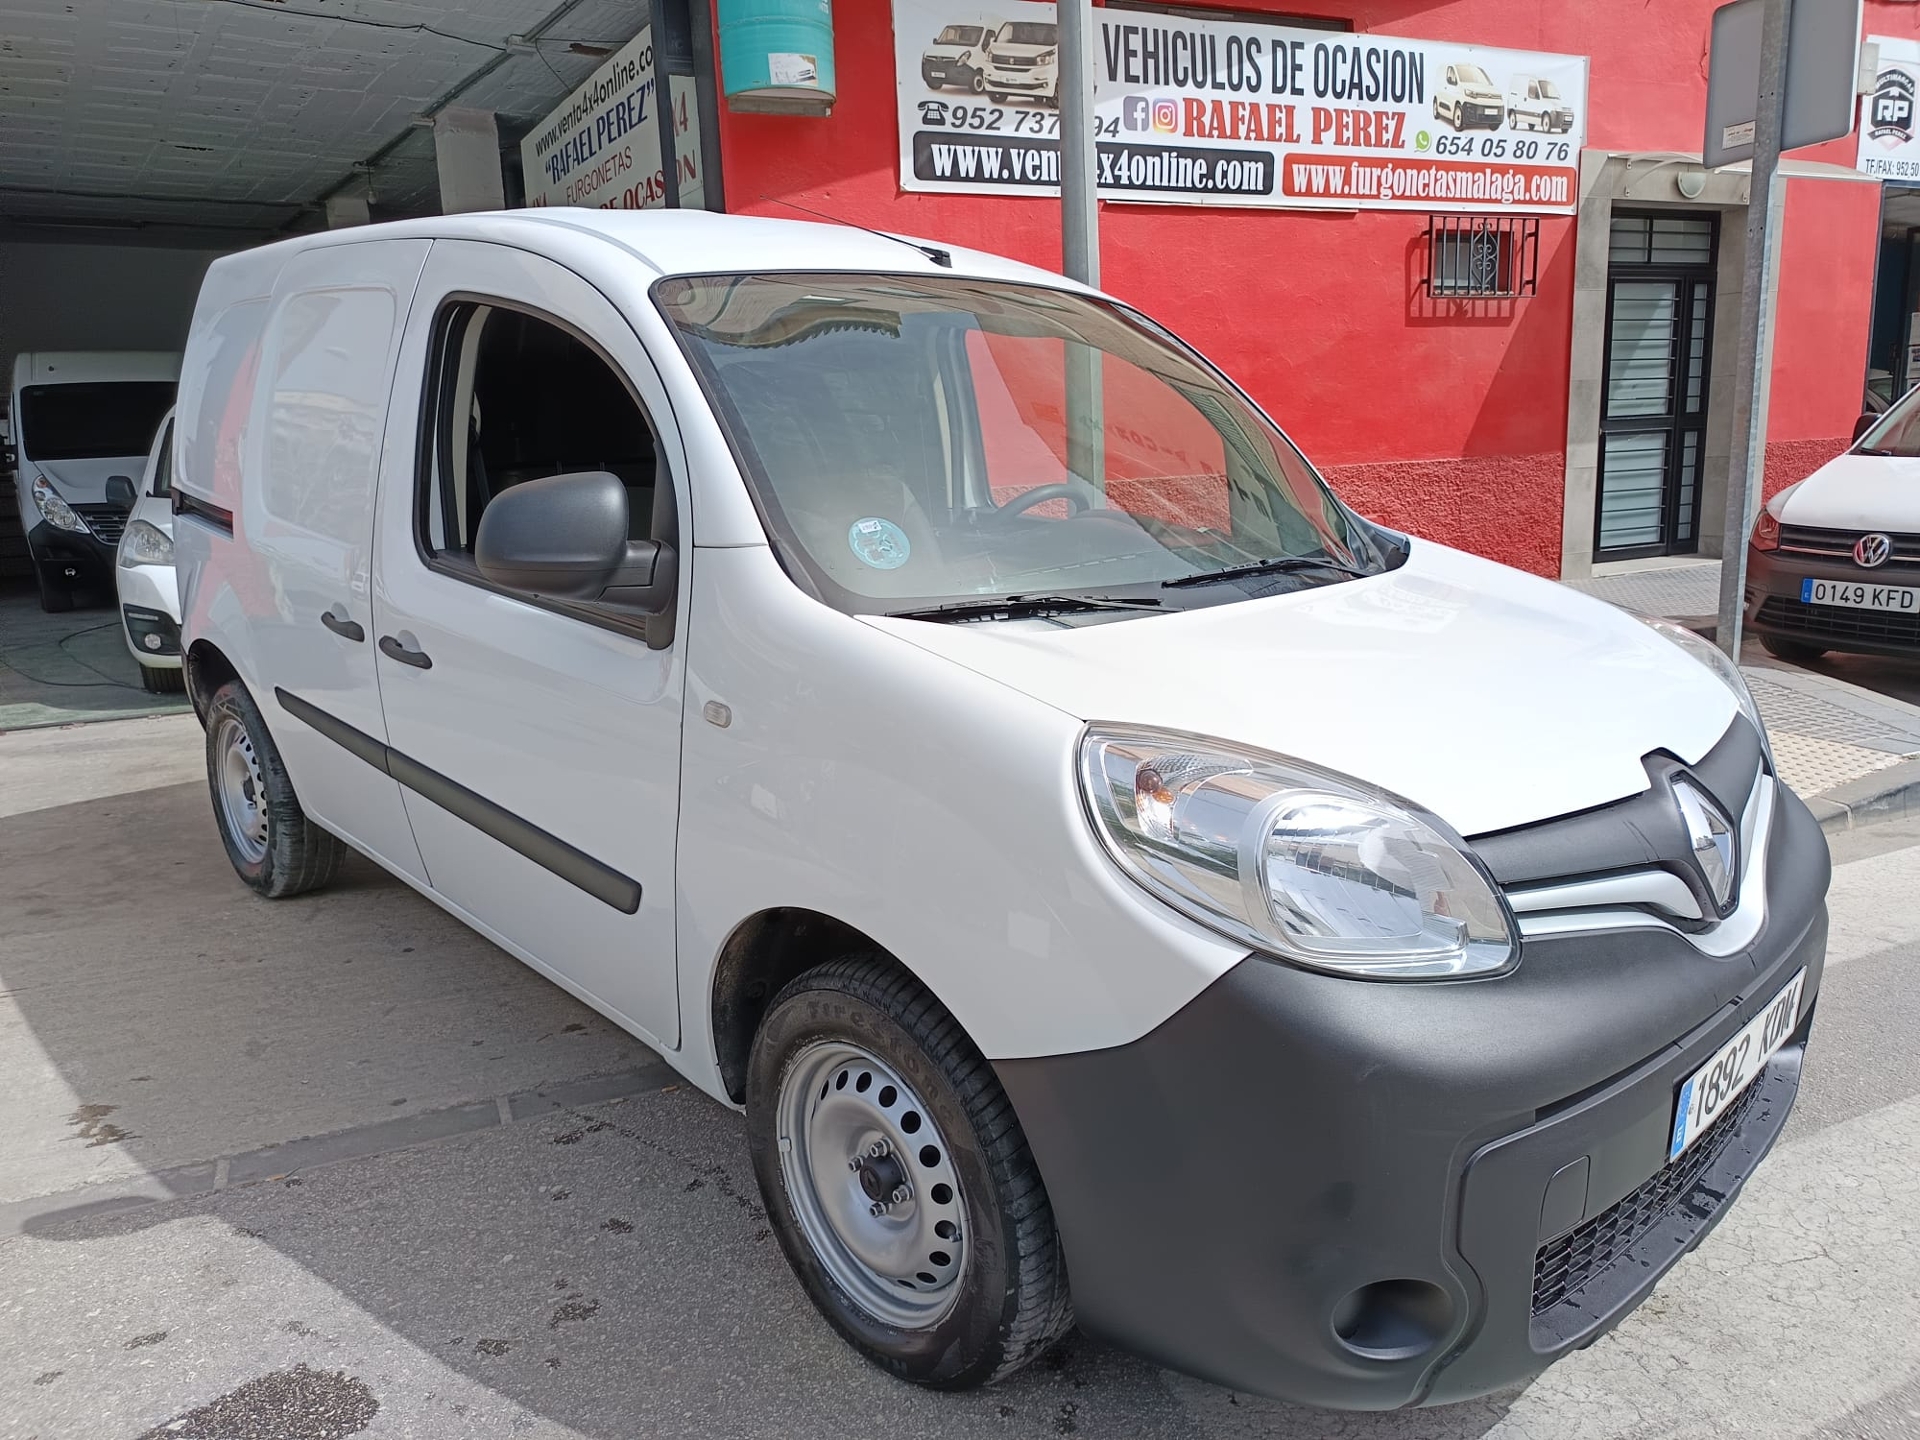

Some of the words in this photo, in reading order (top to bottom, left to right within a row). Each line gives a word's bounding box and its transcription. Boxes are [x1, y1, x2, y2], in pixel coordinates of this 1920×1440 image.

[1102, 23, 1262, 93] VEHICULOS
[1271, 39, 1305, 96] DE
[1313, 43, 1424, 104] OCASION
[535, 45, 654, 158] www.venta4x4online.co
[950, 106, 1004, 131] 952
[1013, 110, 1060, 135] 737
[1183, 97, 1301, 144] RAFAEL
[1311, 106, 1406, 149] PEREZ
[1877, 99, 1909, 121] RP
[931, 143, 1264, 191] www.venx4online.com
[1436, 135, 1474, 156] 654
[1481, 138, 1507, 158] 05
[1513, 140, 1539, 160] 80
[1546, 142, 1569, 162] 76
[566, 146, 633, 206] FURGONETAS
[1292, 162, 1568, 203] www.furgonetasmalaga.com
[1815, 583, 1865, 604] 0149
[1872, 588, 1914, 609] KFD
[1696, 1033, 1751, 1128] 1892
